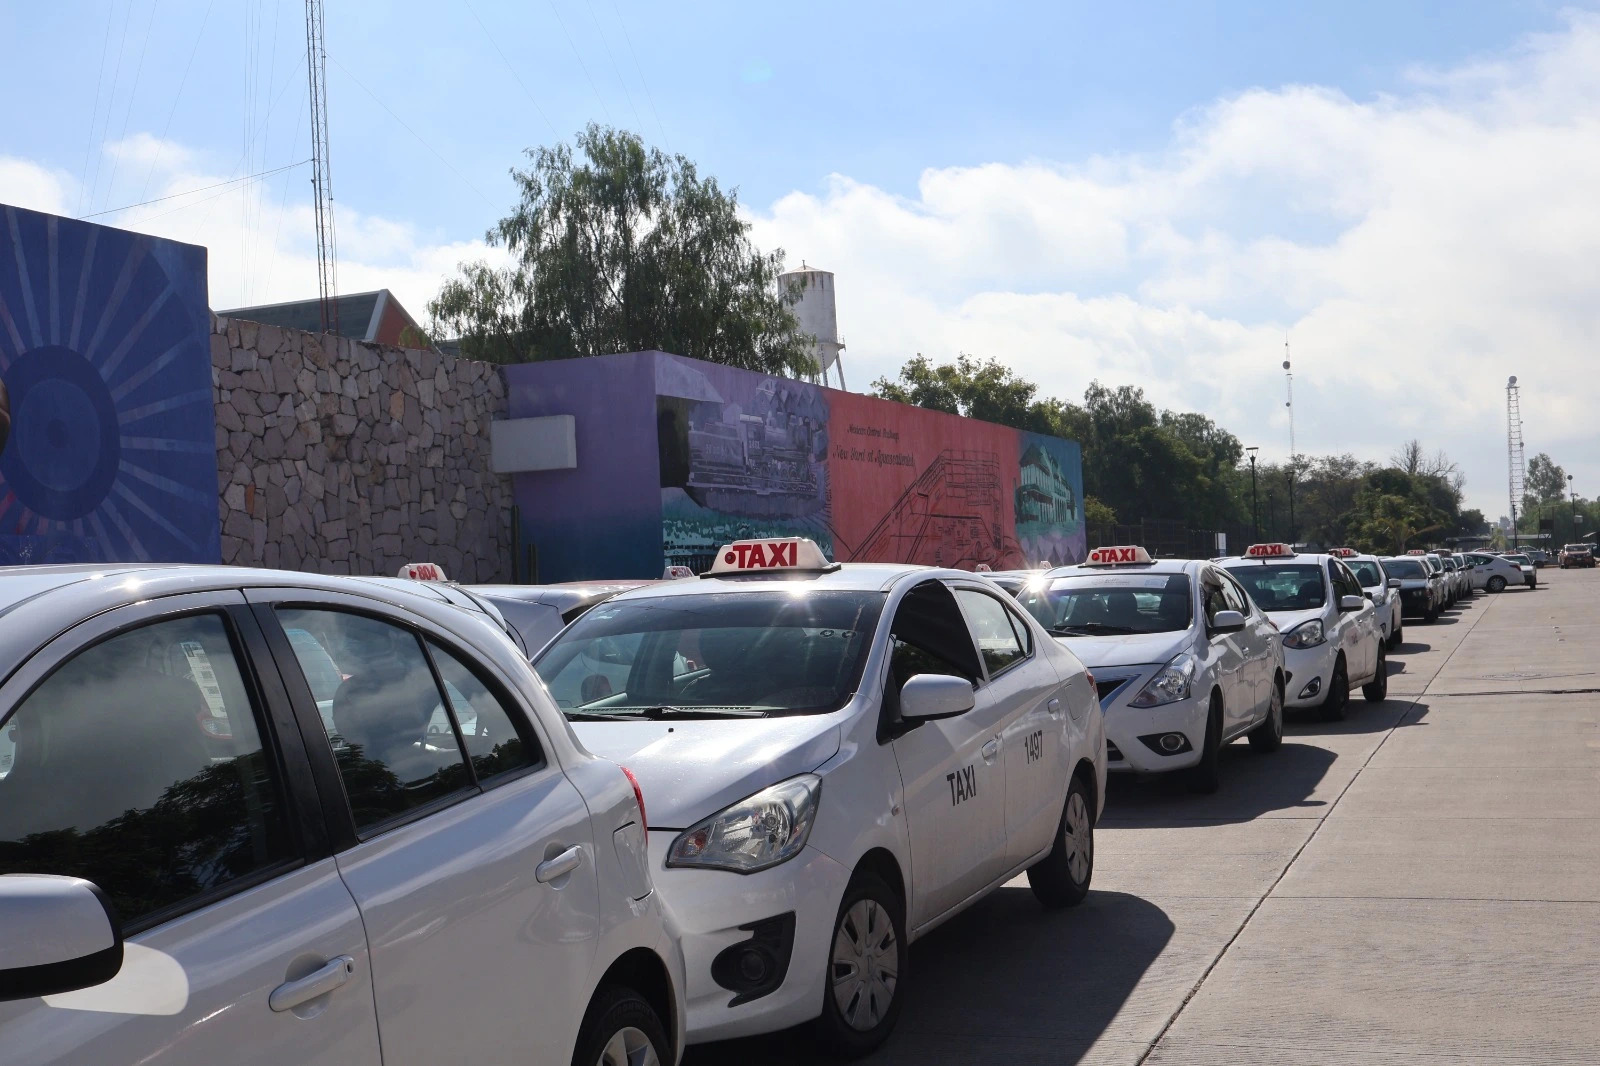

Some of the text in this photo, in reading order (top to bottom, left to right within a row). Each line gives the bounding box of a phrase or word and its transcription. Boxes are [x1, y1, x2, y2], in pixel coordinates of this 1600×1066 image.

[733, 542, 797, 568] TAXI
[1099, 548, 1136, 562] TAXI
[1255, 545, 1282, 555] TAXI
[417, 565, 438, 580] 804
[1024, 730, 1043, 765] 1497
[946, 764, 977, 807] TAXI
